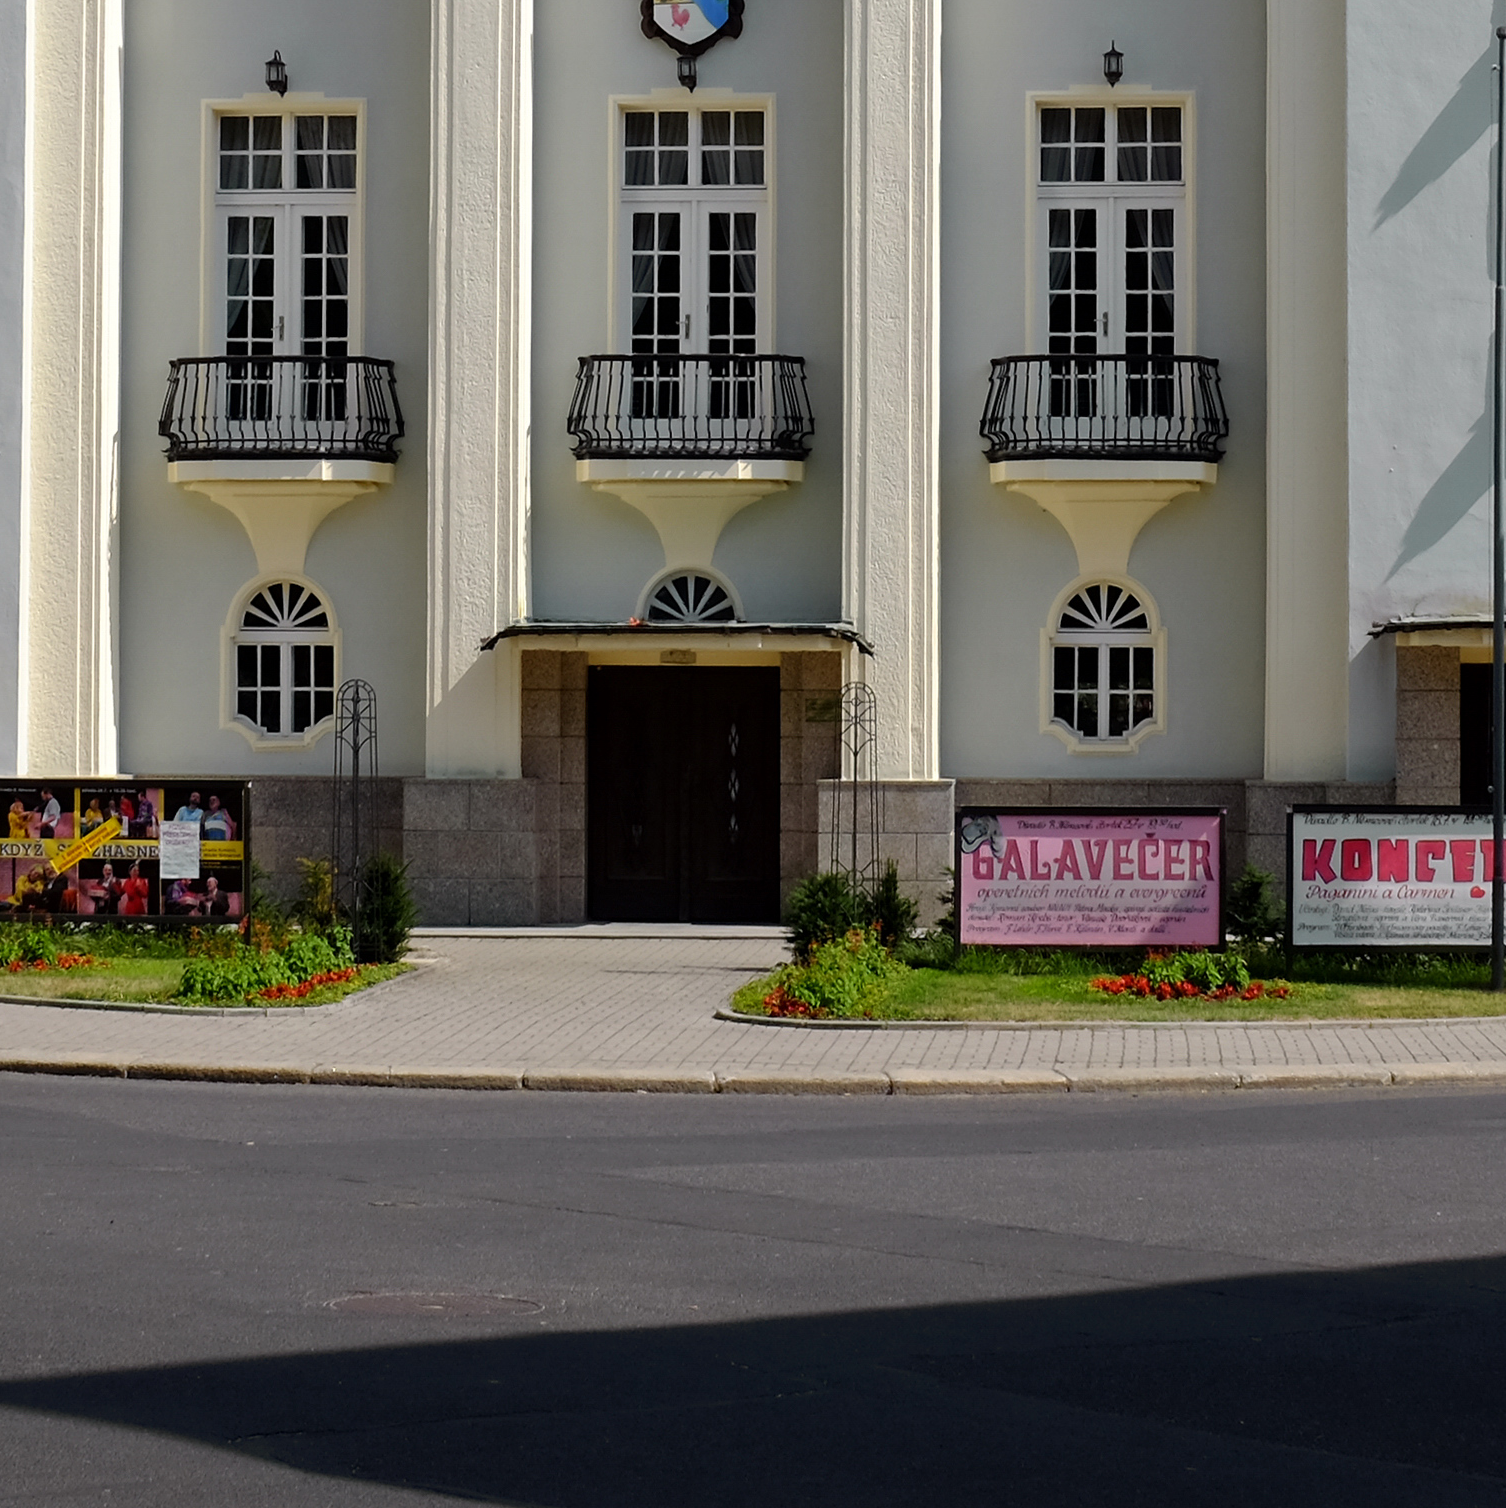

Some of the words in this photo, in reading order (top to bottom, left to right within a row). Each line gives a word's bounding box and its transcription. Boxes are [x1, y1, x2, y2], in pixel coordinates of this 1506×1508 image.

[0, 840, 43, 857] KDYŽ
[972, 833, 1214, 881] GALAVEČER
[977, 884, 1049, 902] operetních
[1054, 884, 1112, 899] melodií
[1114, 888, 1125, 899] a
[1130, 884, 1207, 903] evergreenů
[1305, 884, 1378, 902] Paganini
[1381, 888, 1393, 899] a
[1397, 884, 1454, 900] Carmen
